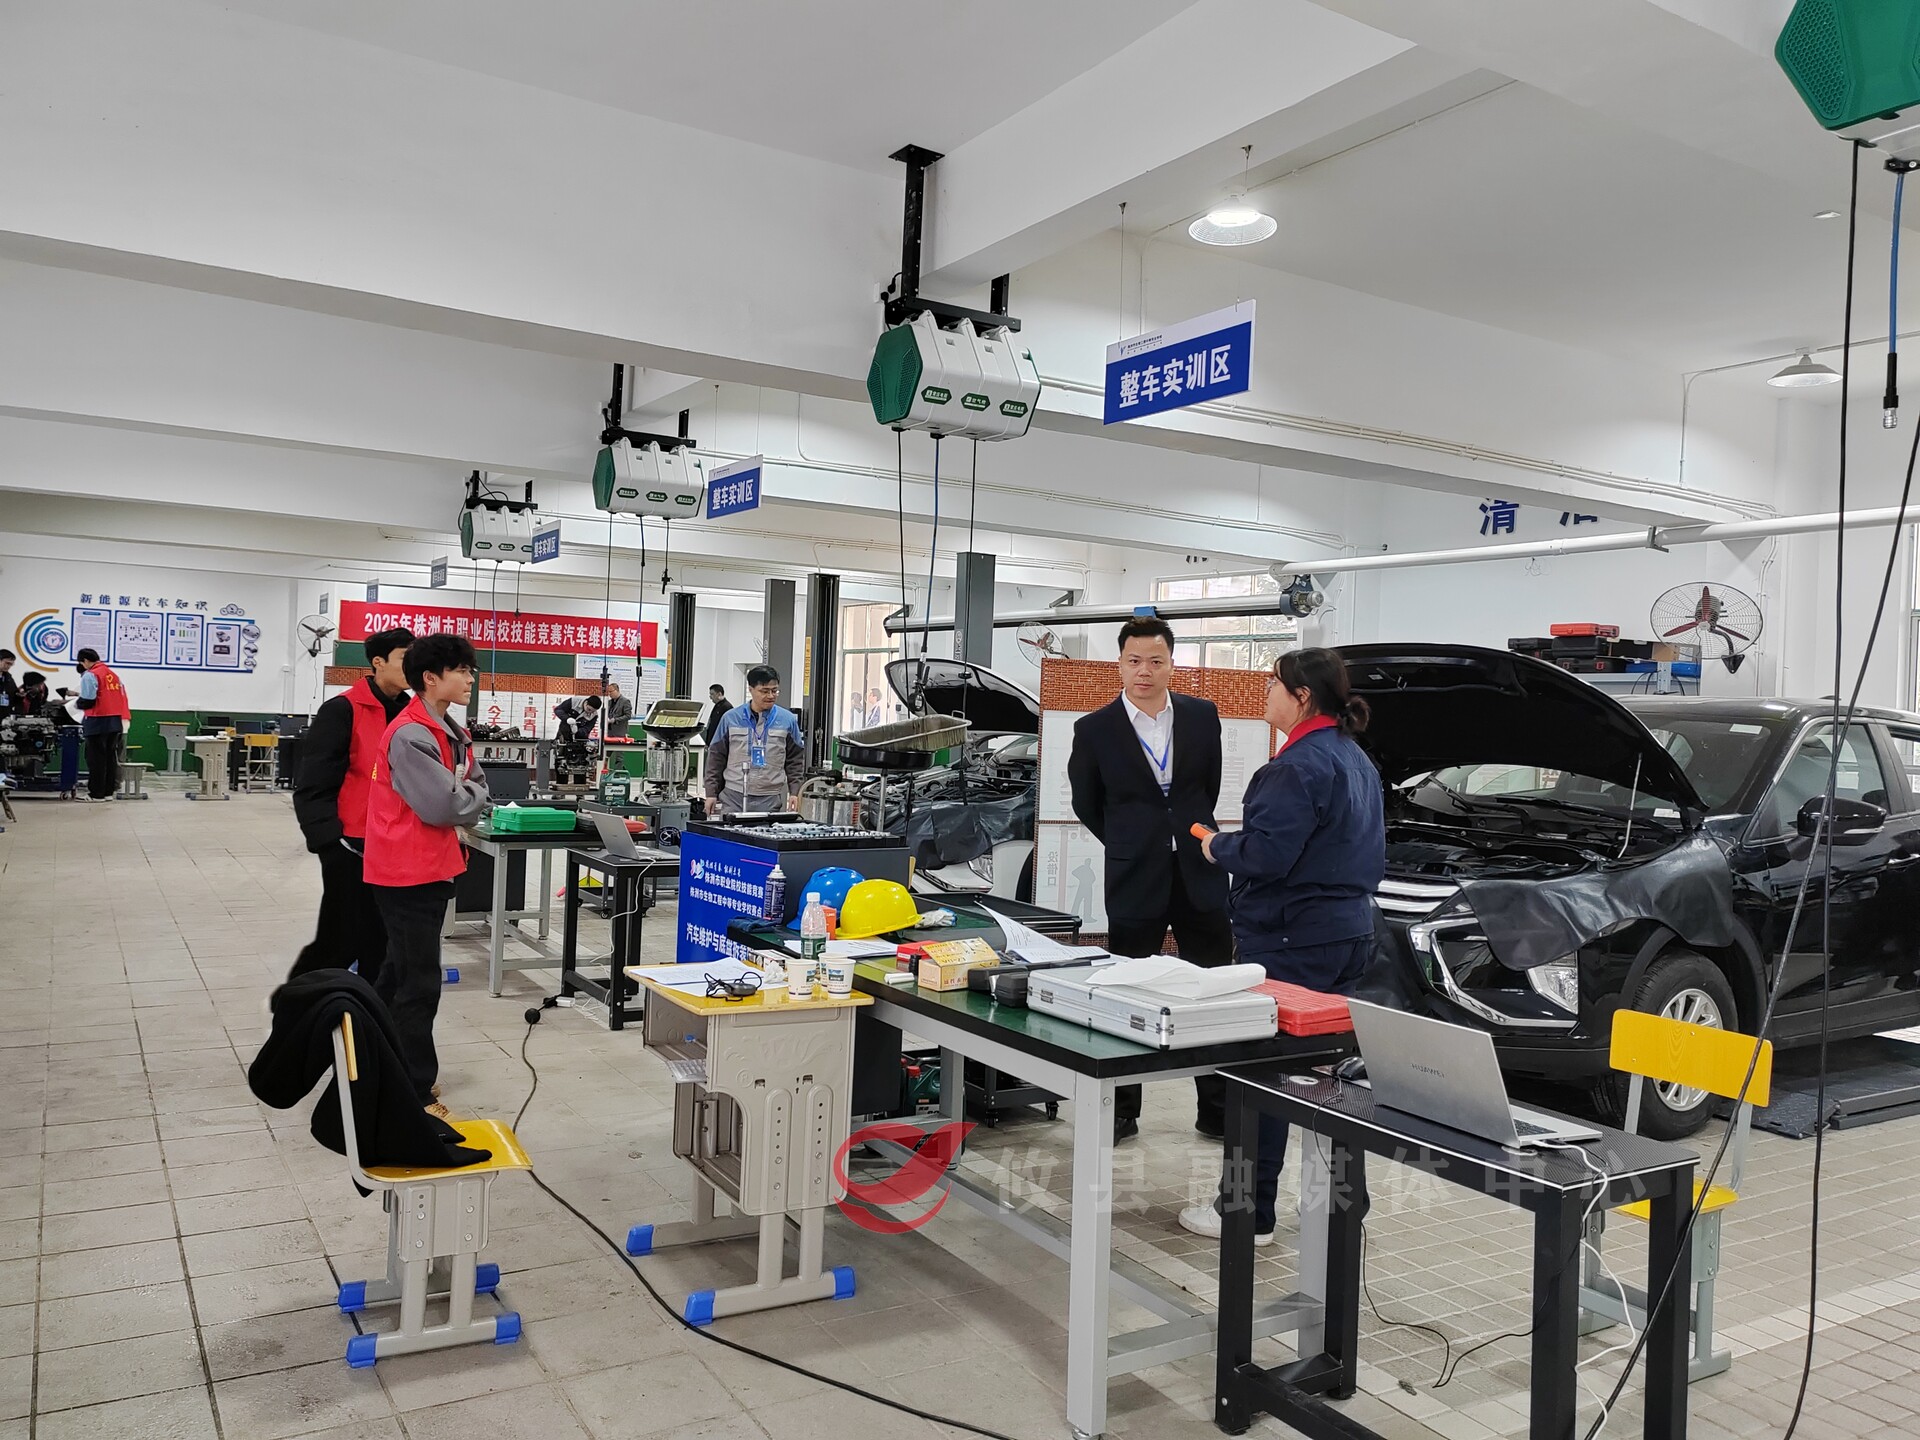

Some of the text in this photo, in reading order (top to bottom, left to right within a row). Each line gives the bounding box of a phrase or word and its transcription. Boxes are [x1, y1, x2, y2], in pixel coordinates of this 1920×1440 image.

[1119, 344, 1231, 409] 整车实训区
[712, 479, 754, 511] 整车实训区
[80, 593, 208, 612] 新能源汽车知识
[364, 612, 640, 651] 2025年株洲市职业院校技能竞赛汽车维修赛场
[704, 871, 764, 899] 株洲市职业院校技能竞赛
